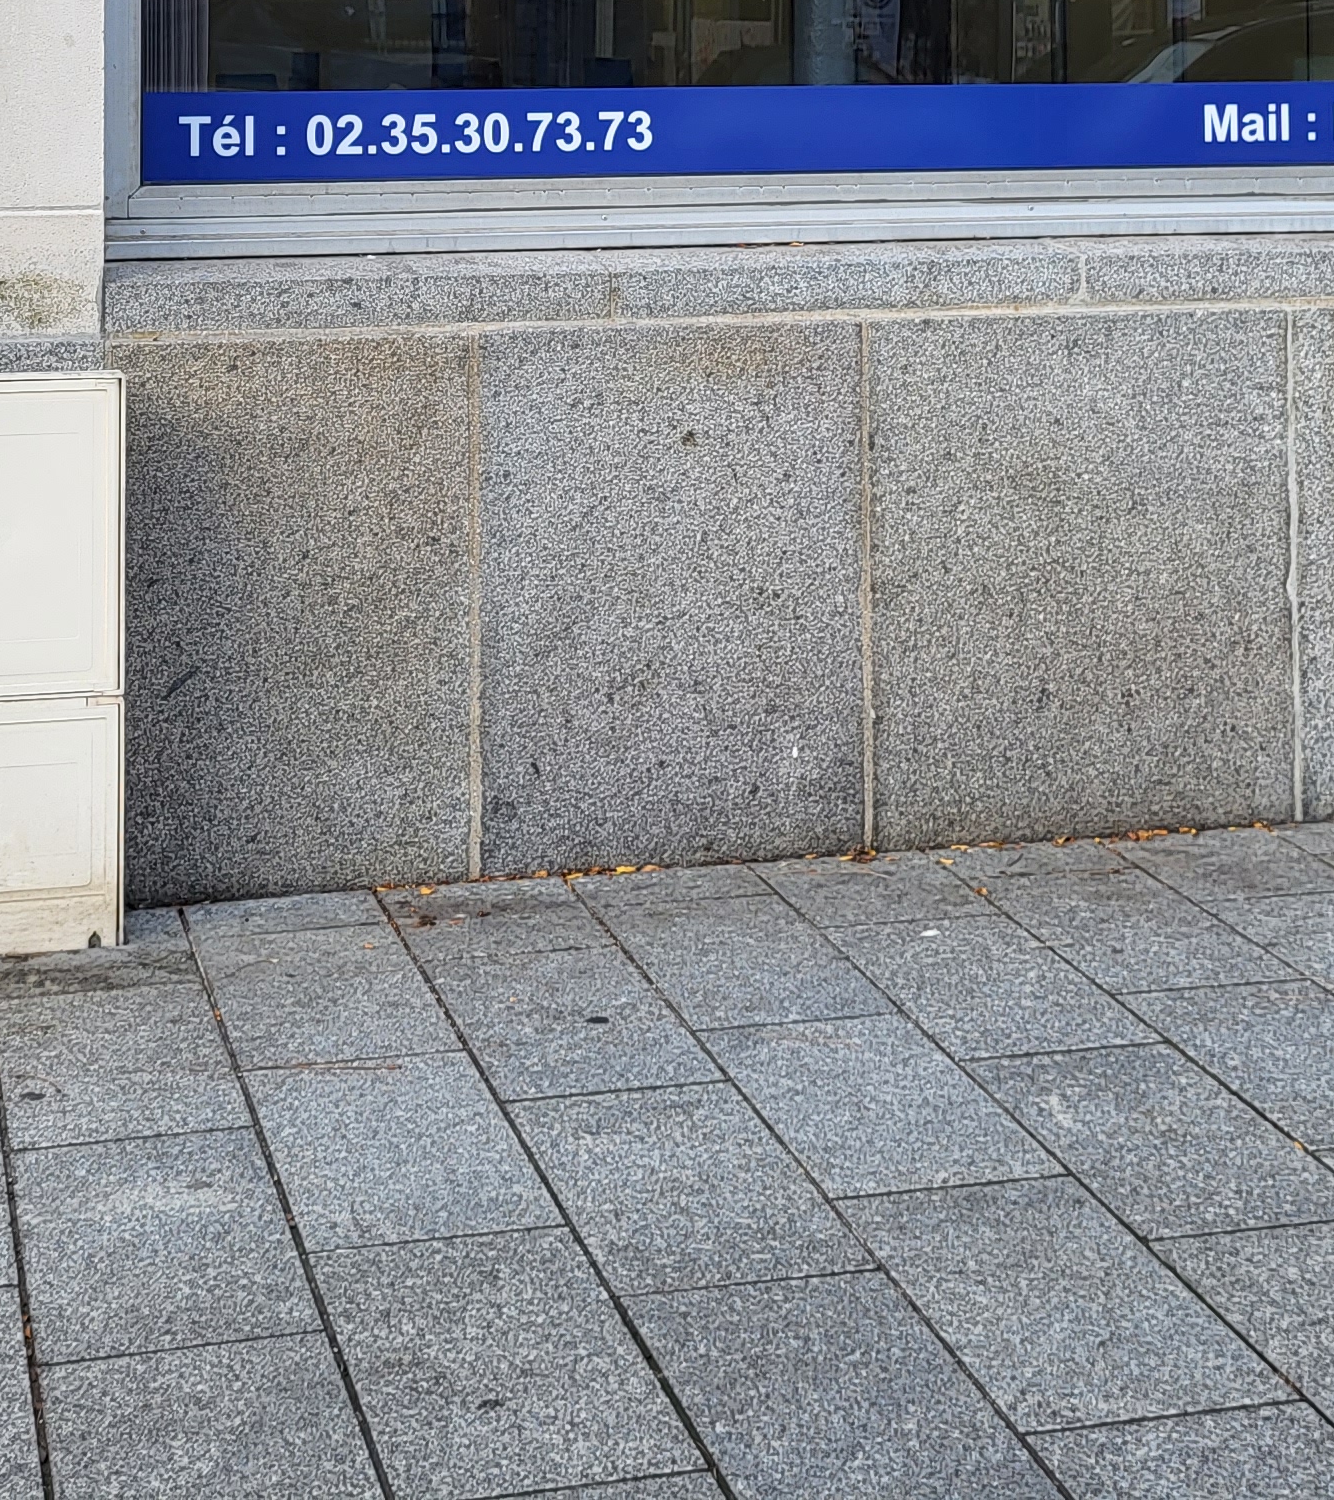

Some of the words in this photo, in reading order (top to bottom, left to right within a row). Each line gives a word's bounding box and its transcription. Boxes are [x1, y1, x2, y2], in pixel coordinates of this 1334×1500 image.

[179, 115, 253, 156] Tél
[307, 111, 652, 155] 02.35.30.73.73
[1204, 104, 1289, 142] Mail
